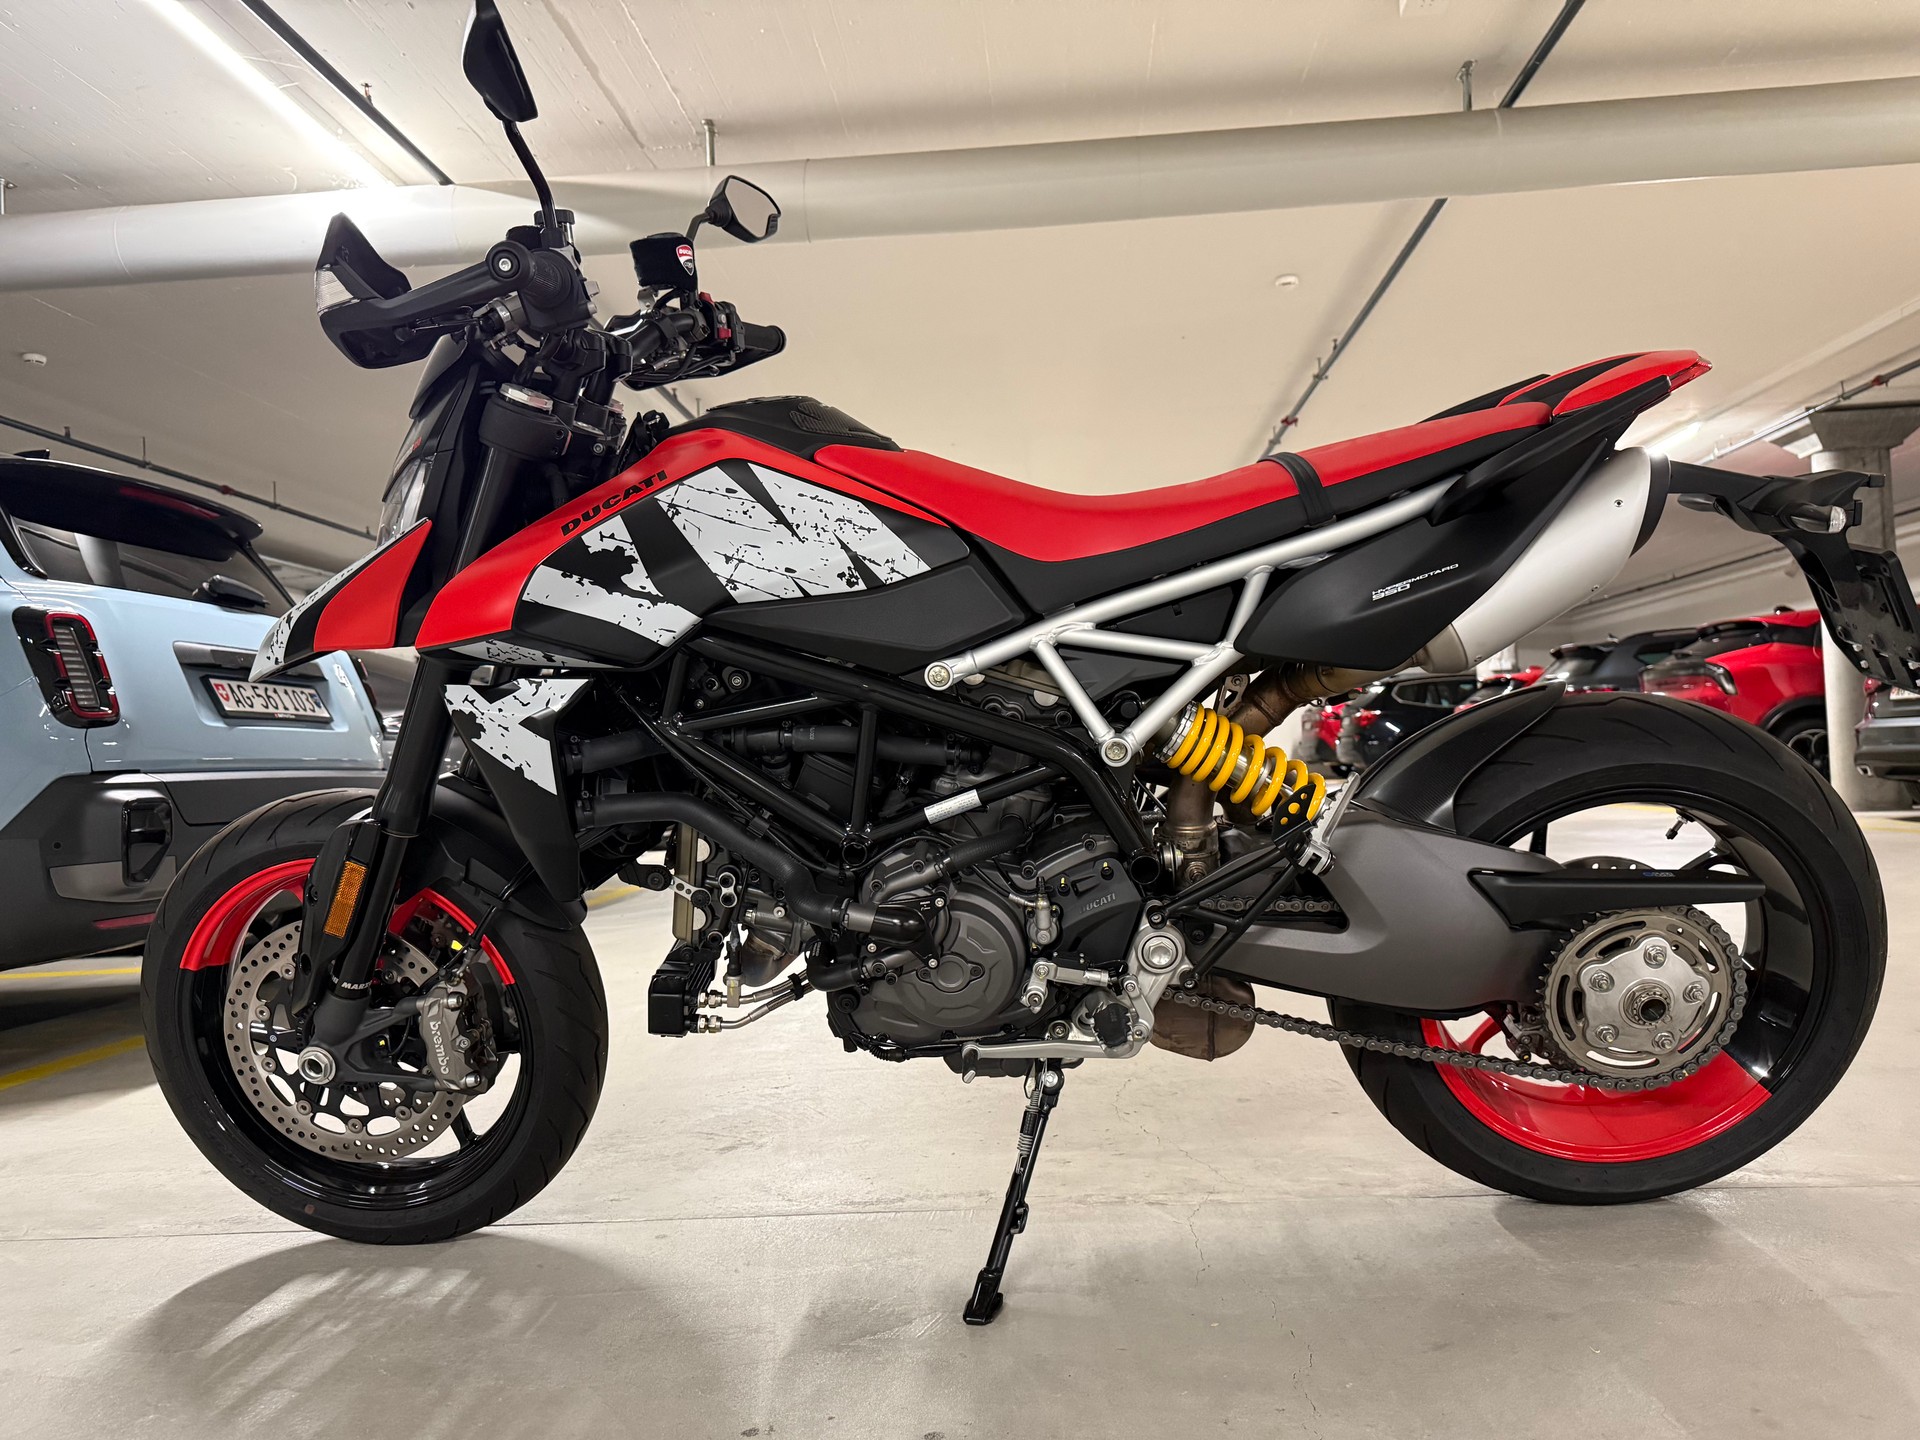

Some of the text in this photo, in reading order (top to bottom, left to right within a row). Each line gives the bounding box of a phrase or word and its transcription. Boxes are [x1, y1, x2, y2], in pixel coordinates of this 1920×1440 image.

[561, 470, 668, 536] DUCATI
[1372, 563, 1459, 595] HYPERMOTARD
[1372, 583, 1411, 601] 950
[429, 1020, 450, 1075] brembo
